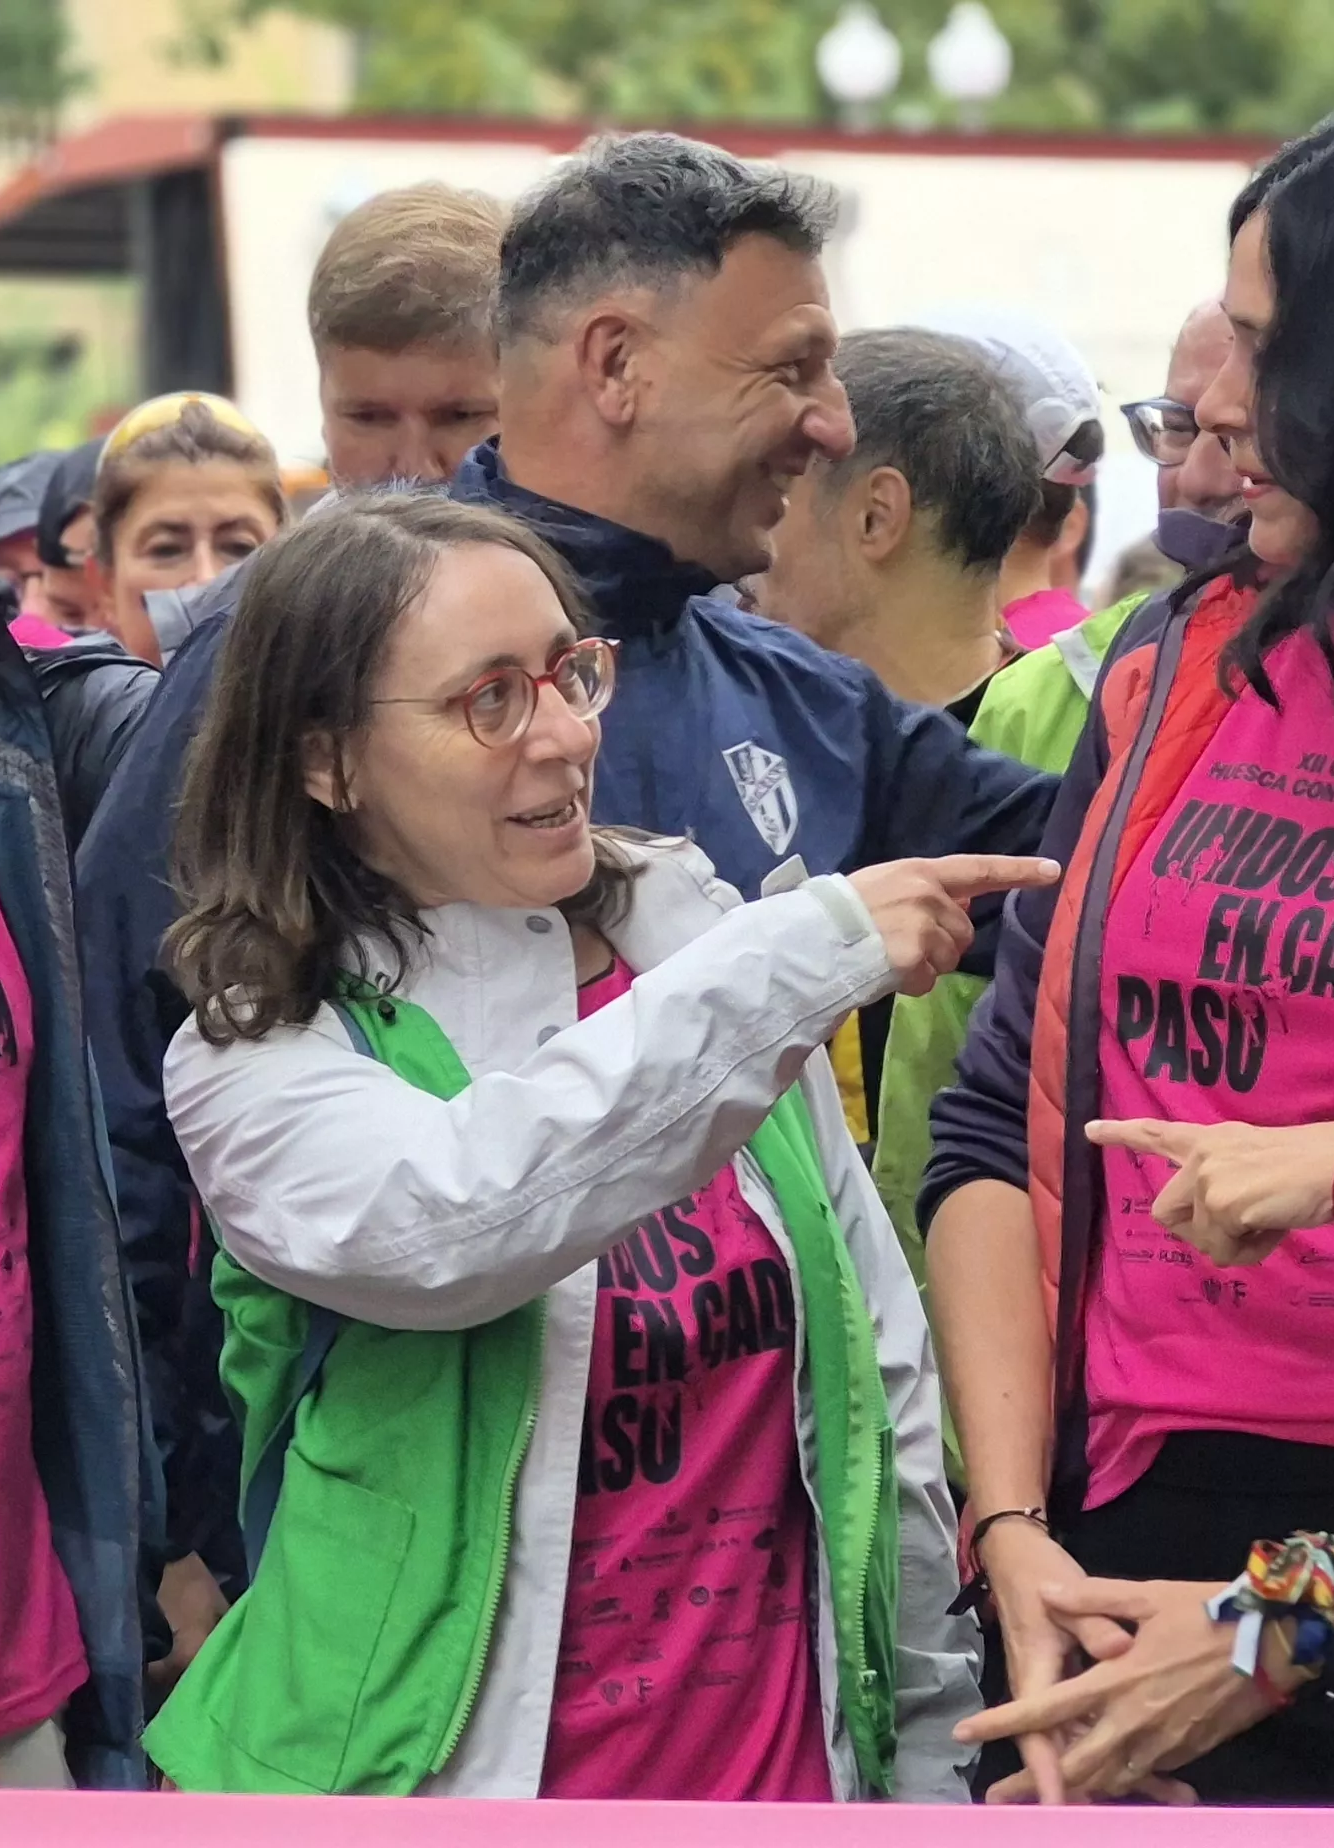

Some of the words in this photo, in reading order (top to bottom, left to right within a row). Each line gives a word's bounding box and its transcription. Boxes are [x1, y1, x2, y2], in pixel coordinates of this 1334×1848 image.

[1209, 760, 1287, 792] HUESCA
[1298, 753, 1327, 774] XII
[1196, 893, 1282, 987] EN
[1117, 974, 1268, 1094] PASO
[612, 1296, 687, 1390] EN
